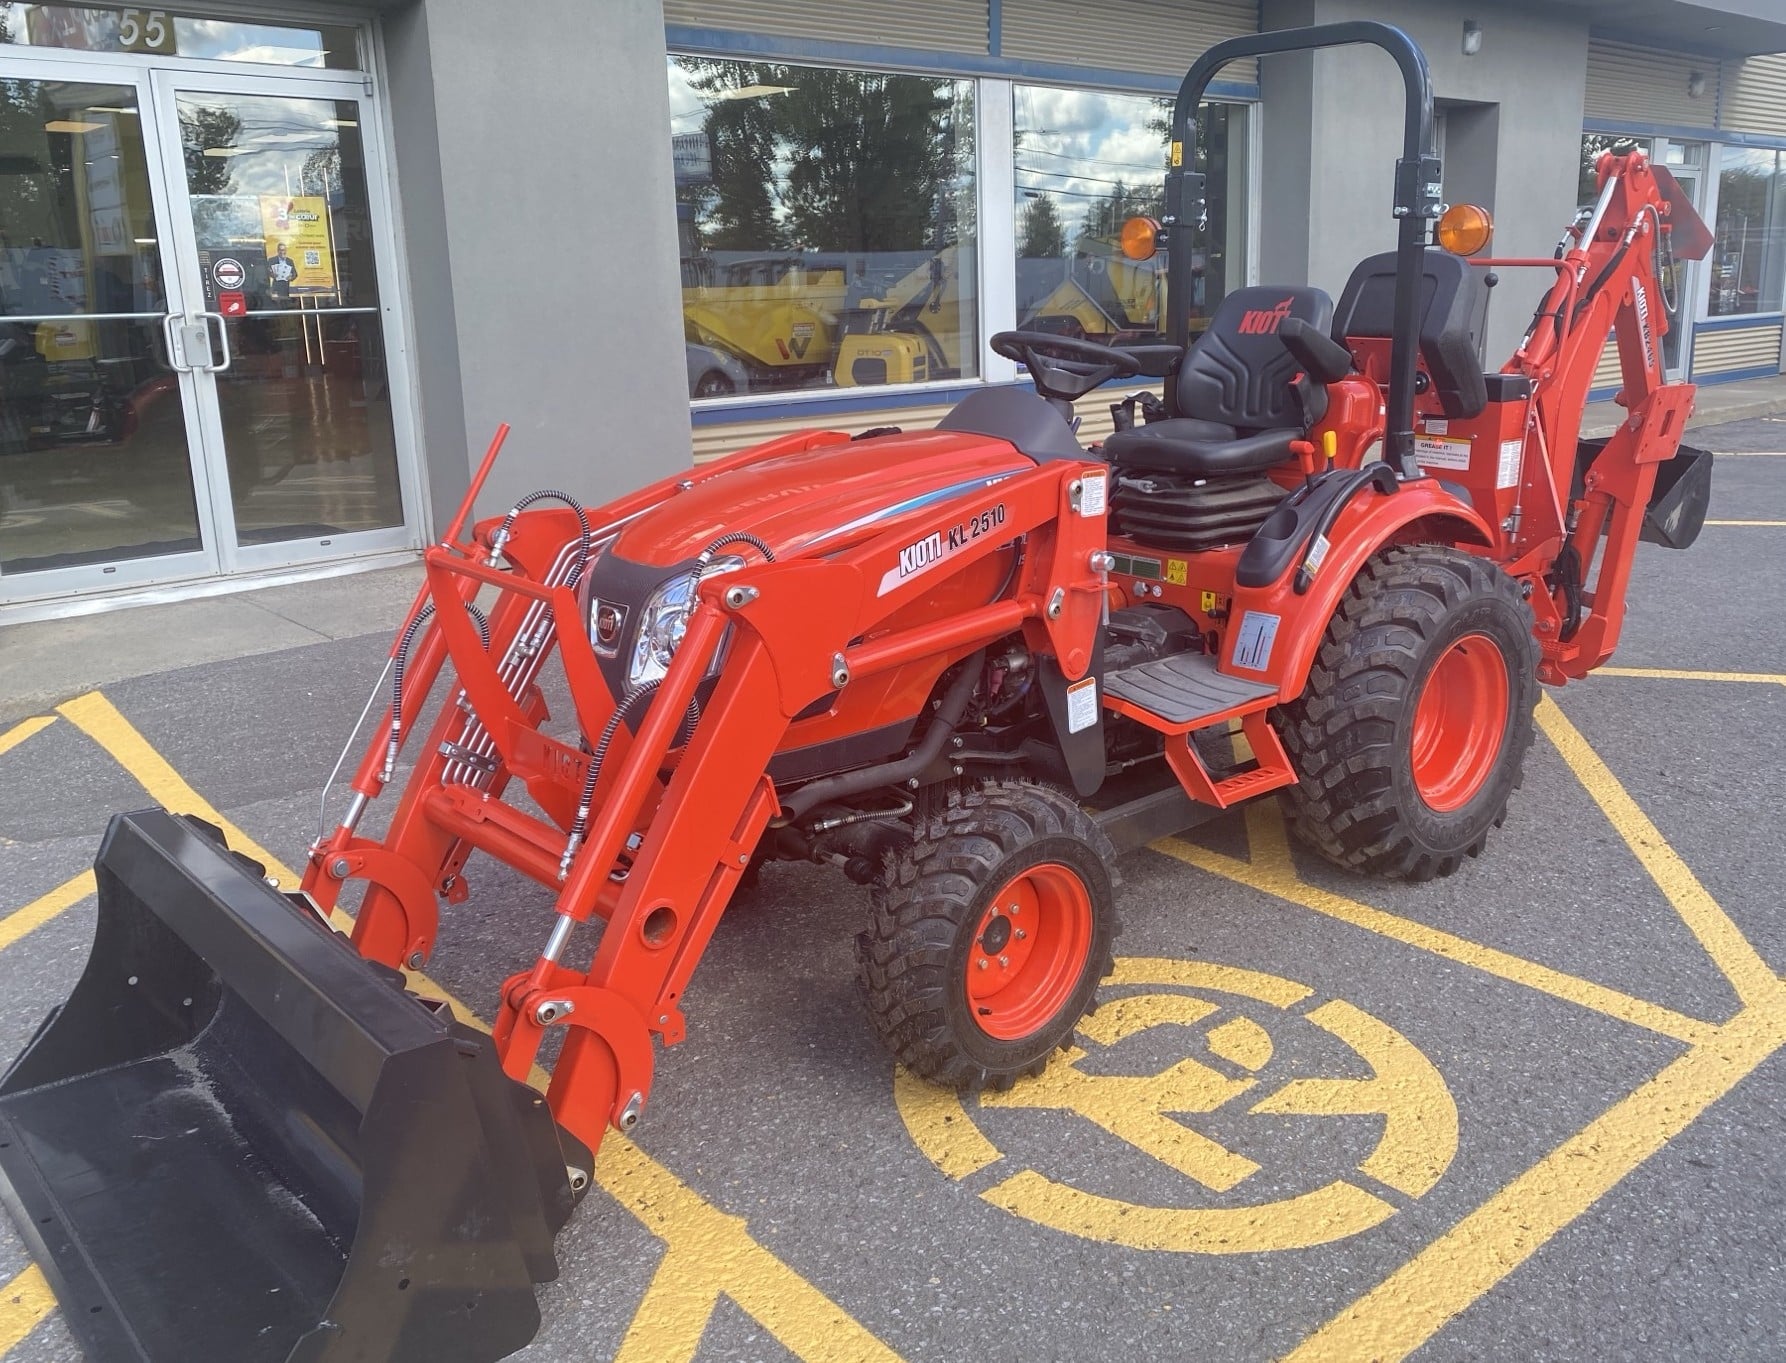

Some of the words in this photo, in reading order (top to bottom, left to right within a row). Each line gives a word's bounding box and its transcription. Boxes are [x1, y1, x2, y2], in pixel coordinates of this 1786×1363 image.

[119, 9, 165, 48] 55
[204, 267, 212, 298] TIREZ
[1637, 286, 1648, 321] KIOTI
[899, 530, 942, 577] KIOTI
[948, 524, 968, 551] KL
[970, 503, 1005, 538] 2510
